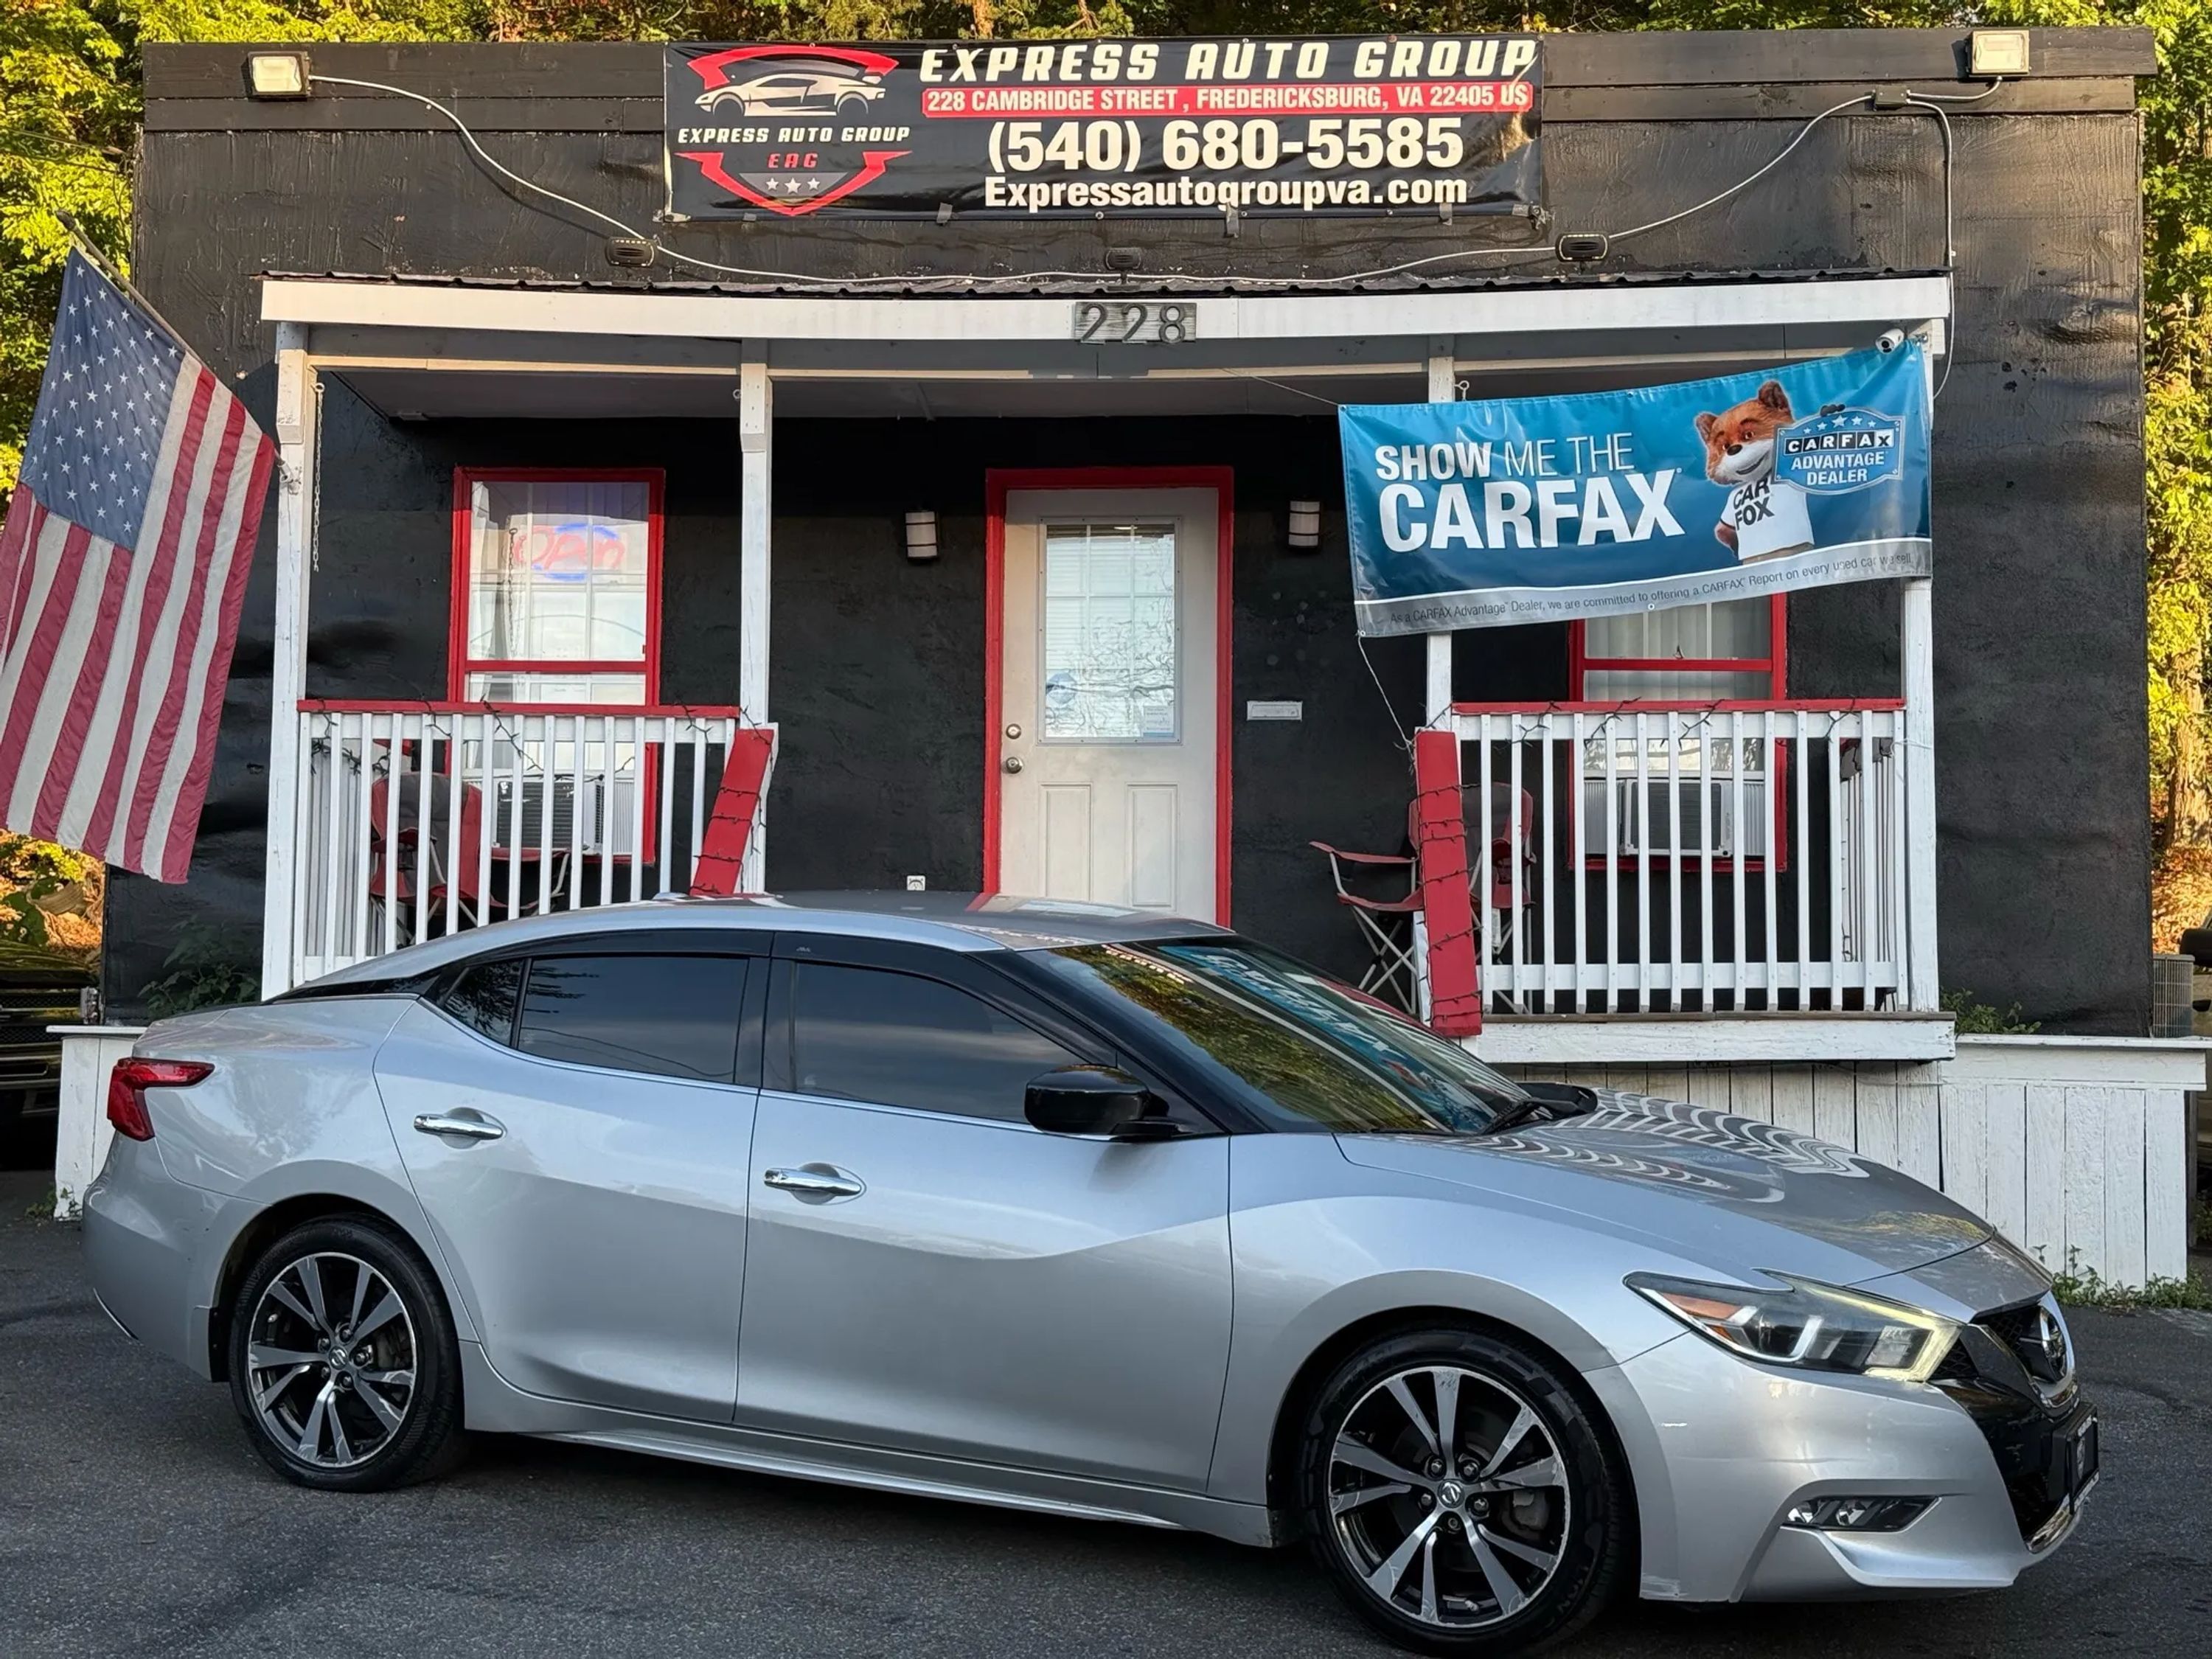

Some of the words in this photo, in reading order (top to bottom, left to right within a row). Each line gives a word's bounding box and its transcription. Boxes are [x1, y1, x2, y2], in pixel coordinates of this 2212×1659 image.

[919, 45, 1158, 82] EXPRESS
[1185, 43, 1329, 80] AUTO
[1354, 40, 1537, 79] GROUP
[926, 91, 965, 111] 228
[970, 89, 1093, 111] CAMBRIDGE
[1099, 88, 1178, 109] STREET
[1197, 86, 1389, 111] FREDERICKSBURG,
[1396, 86, 1425, 107] VA
[1429, 85, 1495, 106] 22405
[1500, 83, 1529, 105] US
[677, 128, 768, 144] EXPRESS
[777, 127, 831, 142] AUTO
[841, 126, 911, 142] GROUP
[988, 122, 1141, 173] (540)
[1162, 118, 1464, 170] 680-5585
[985, 176, 1467, 212] Expressautogroupva.com
[1080, 303, 1186, 344] 228
[1375, 442, 1492, 481] SHOW
[1503, 439, 1559, 477] ME
[1567, 433, 1635, 473] THE
[1788, 434, 1891, 452] CARFAX
[1792, 452, 1885, 470] ADVANTAGE
[1807, 469, 1867, 486] DEALER
[1379, 468, 1686, 552] CARFAX
[1733, 477, 1770, 509] CAR
[1735, 497, 1775, 530] FOX
[1391, 613, 1402, 624] As
[1405, 613, 1411, 622] a
[1413, 607, 1451, 622] CARFAX
[1453, 602, 1506, 617] Advantage
[1511, 599, 1546, 613] Dealer,
[1547, 600, 1562, 610] we
[1565, 599, 1580, 610] are
[1583, 593, 1636, 608] committed
[1638, 591, 1649, 602] to
[1651, 587, 1689, 601] offering
[1693, 587, 1700, 596] a
[1702, 577, 1744, 594] CARFAX
[1748, 572, 1784, 587] Report
[1786, 571, 1800, 580] on
[1803, 562, 1830, 579] every
